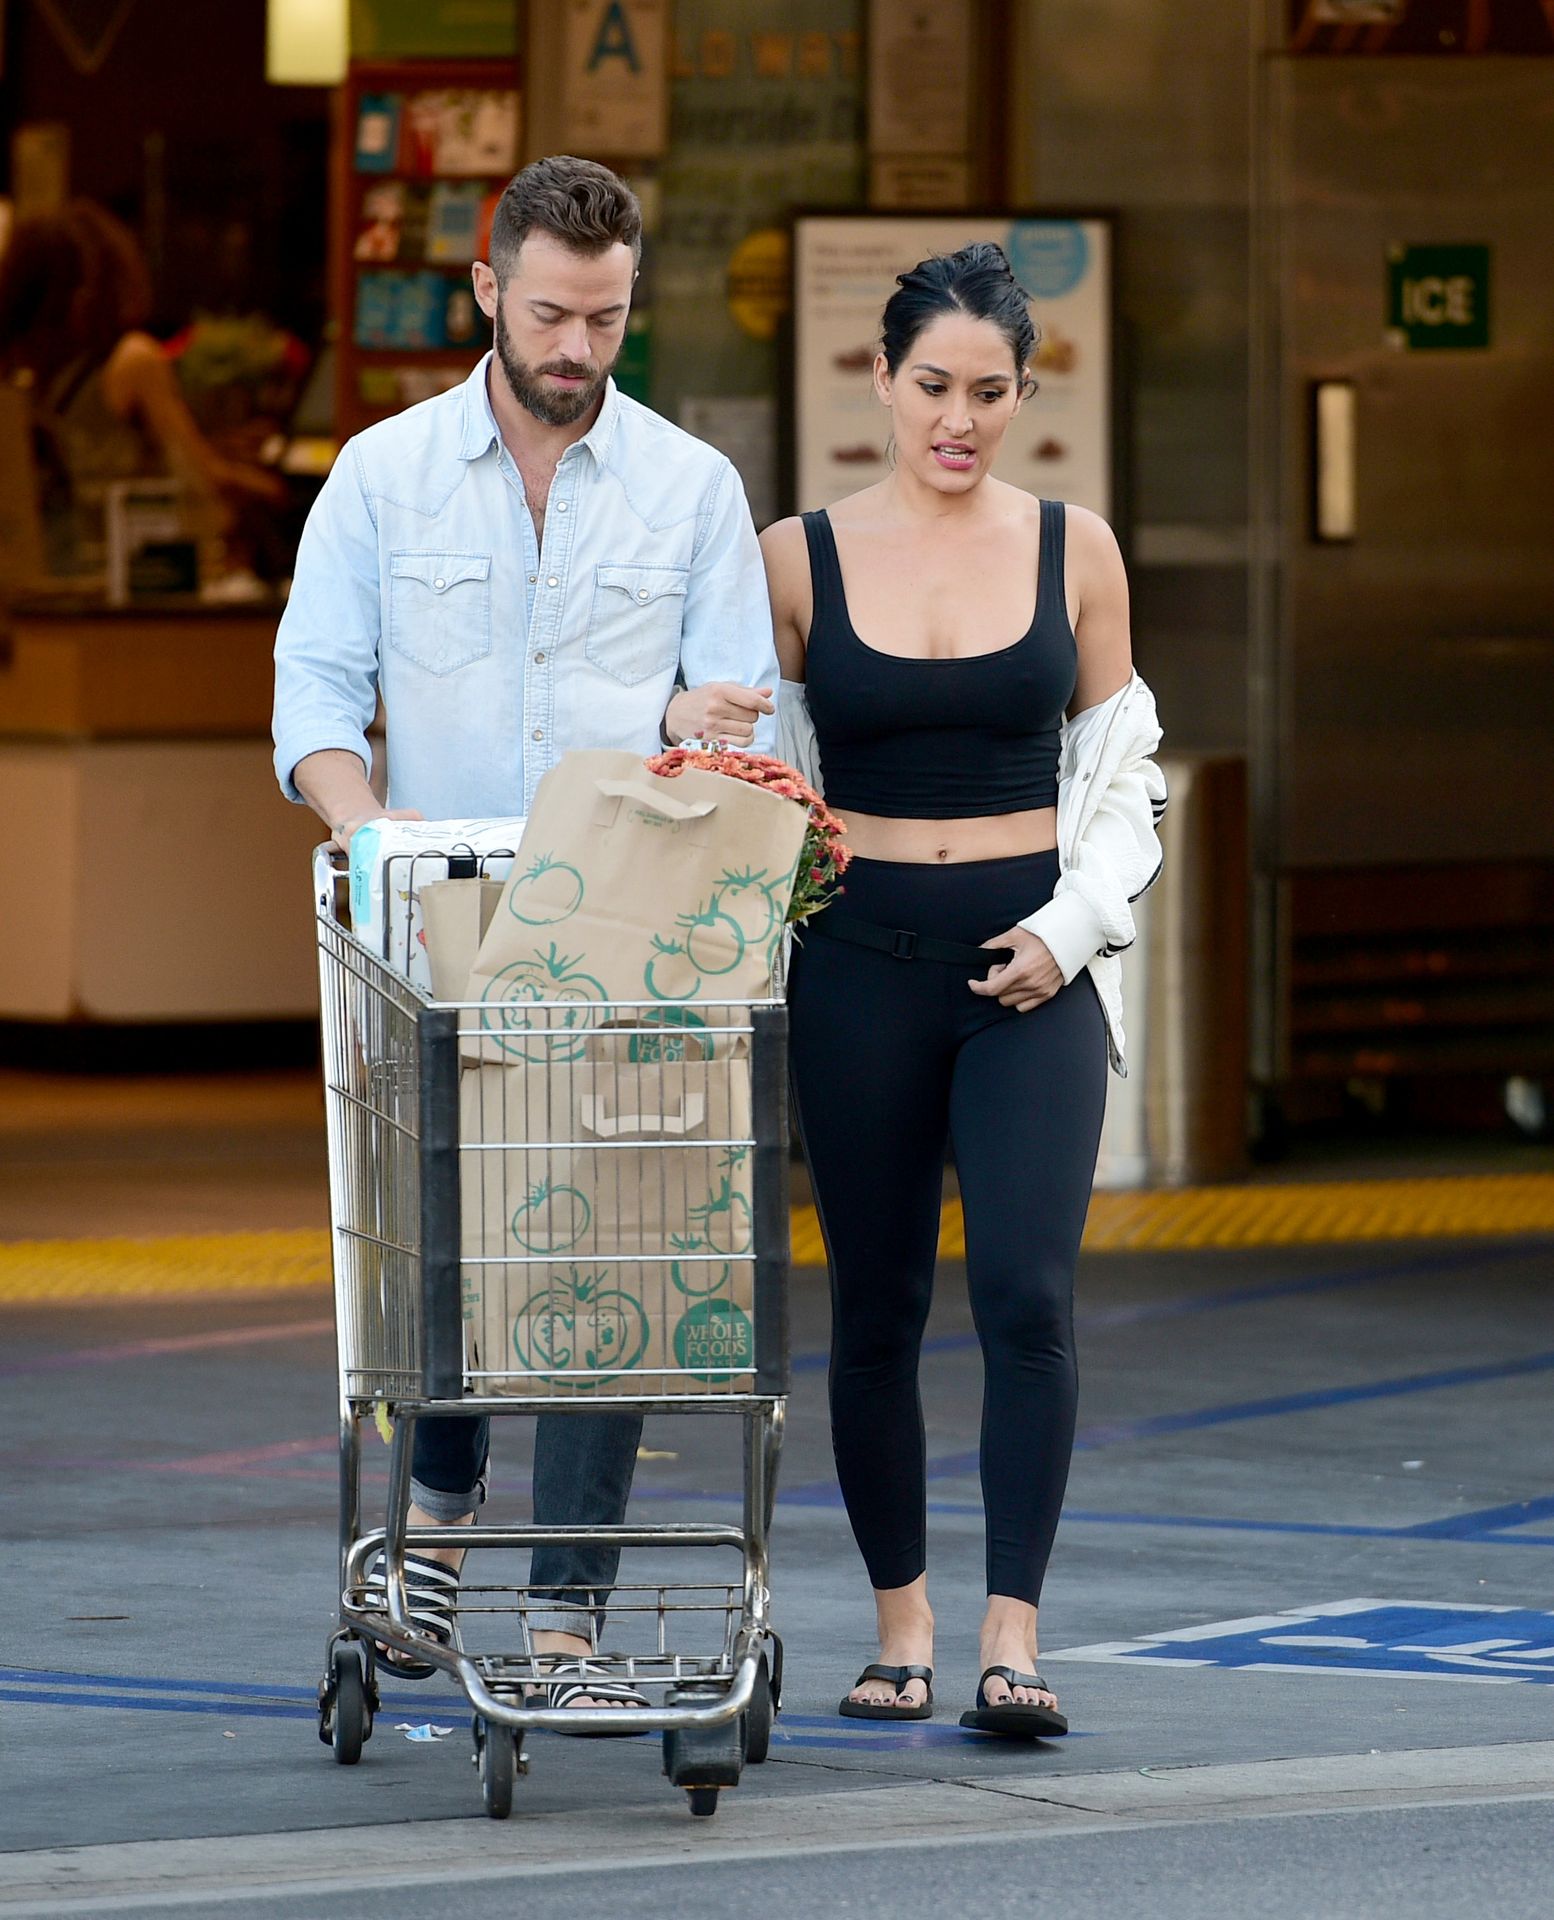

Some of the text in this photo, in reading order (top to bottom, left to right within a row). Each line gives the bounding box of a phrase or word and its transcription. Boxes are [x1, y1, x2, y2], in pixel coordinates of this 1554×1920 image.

[585, 0, 643, 74] A
[1402, 275, 1476, 326] ICE
[682, 1322, 747, 1341] WHOLE
[687, 1339, 747, 1357] FOODS
